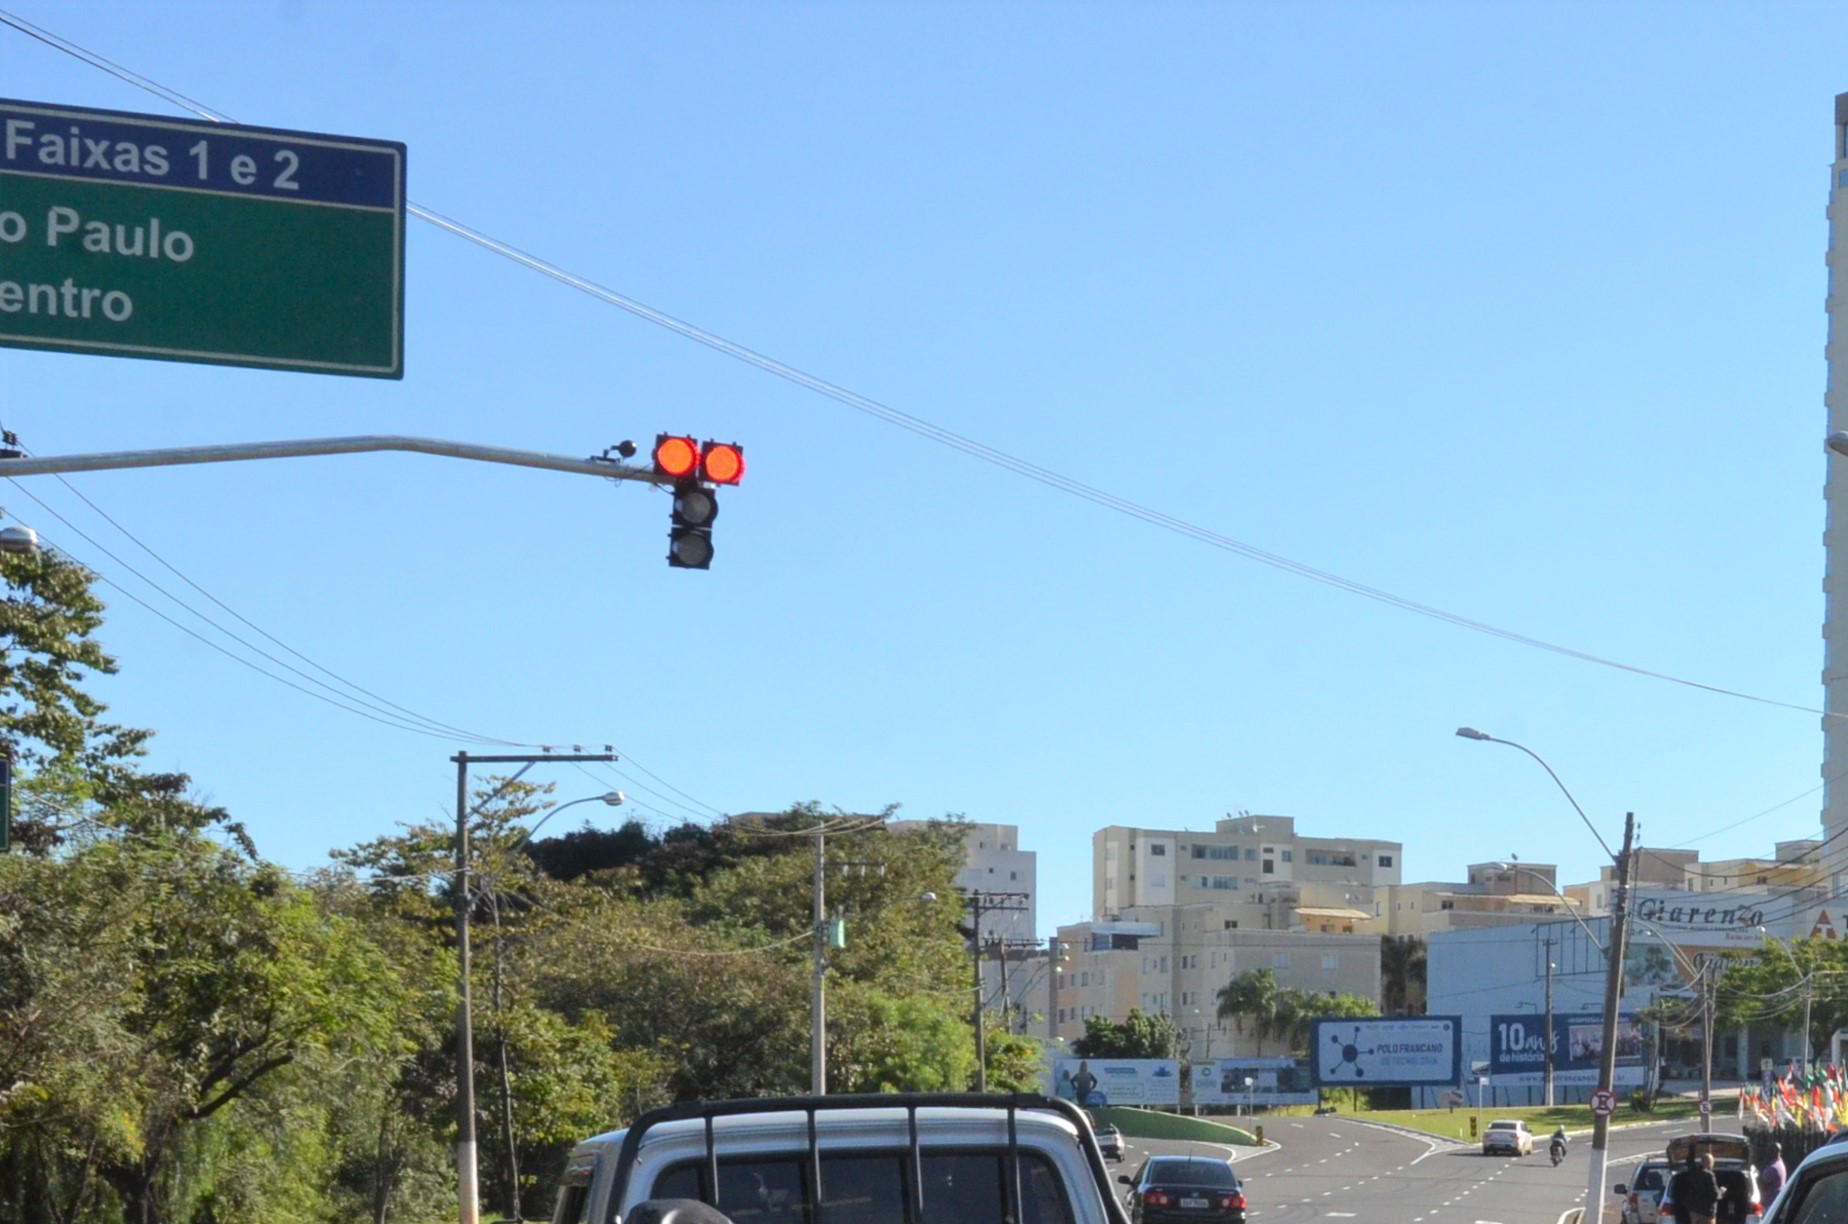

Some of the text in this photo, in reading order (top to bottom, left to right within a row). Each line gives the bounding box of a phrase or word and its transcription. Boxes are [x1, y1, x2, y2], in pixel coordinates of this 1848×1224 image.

[5, 119, 300, 190] Faixas 1 e 2
[47, 206, 195, 262] Paulo
[0, 277, 133, 322] entro
[1376, 1043, 1443, 1054] POLO FRANCANO
[1498, 1022, 1526, 1051] 10
